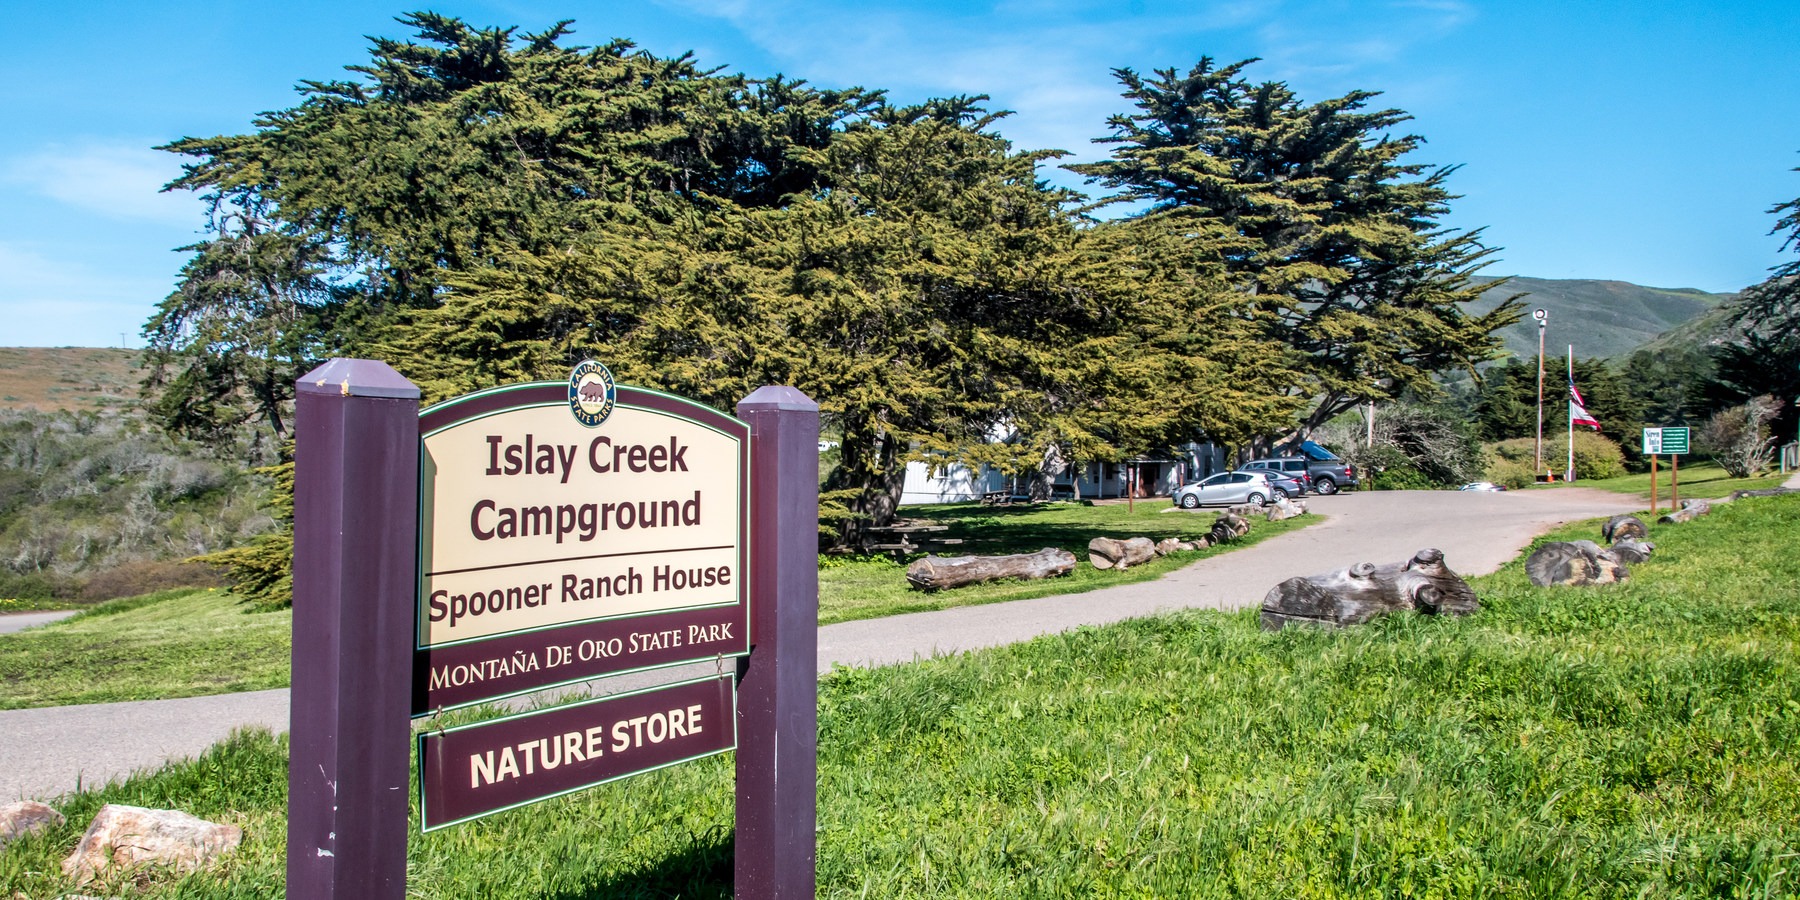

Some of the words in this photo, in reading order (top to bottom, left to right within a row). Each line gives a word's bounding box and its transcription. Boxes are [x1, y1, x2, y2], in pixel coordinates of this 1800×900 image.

[571, 364, 612, 391] CALIFORNIA
[571, 396, 591, 423] STATE
[594, 399, 613, 423] PARKS
[485, 433, 578, 484] Islay
[588, 435, 689, 474] Creek
[470, 490, 701, 545] Campground
[428, 583, 553, 628] Spooner
[561, 567, 643, 603] Ranch
[653, 565, 731, 592] House
[429, 650, 541, 691] MONTAÑA
[546, 645, 573, 668] DE
[578, 637, 623, 662] ORO
[628, 629, 683, 655] STATE
[687, 622, 734, 645] PARK
[470, 725, 603, 789] NATURE
[611, 704, 703, 753] STORE
